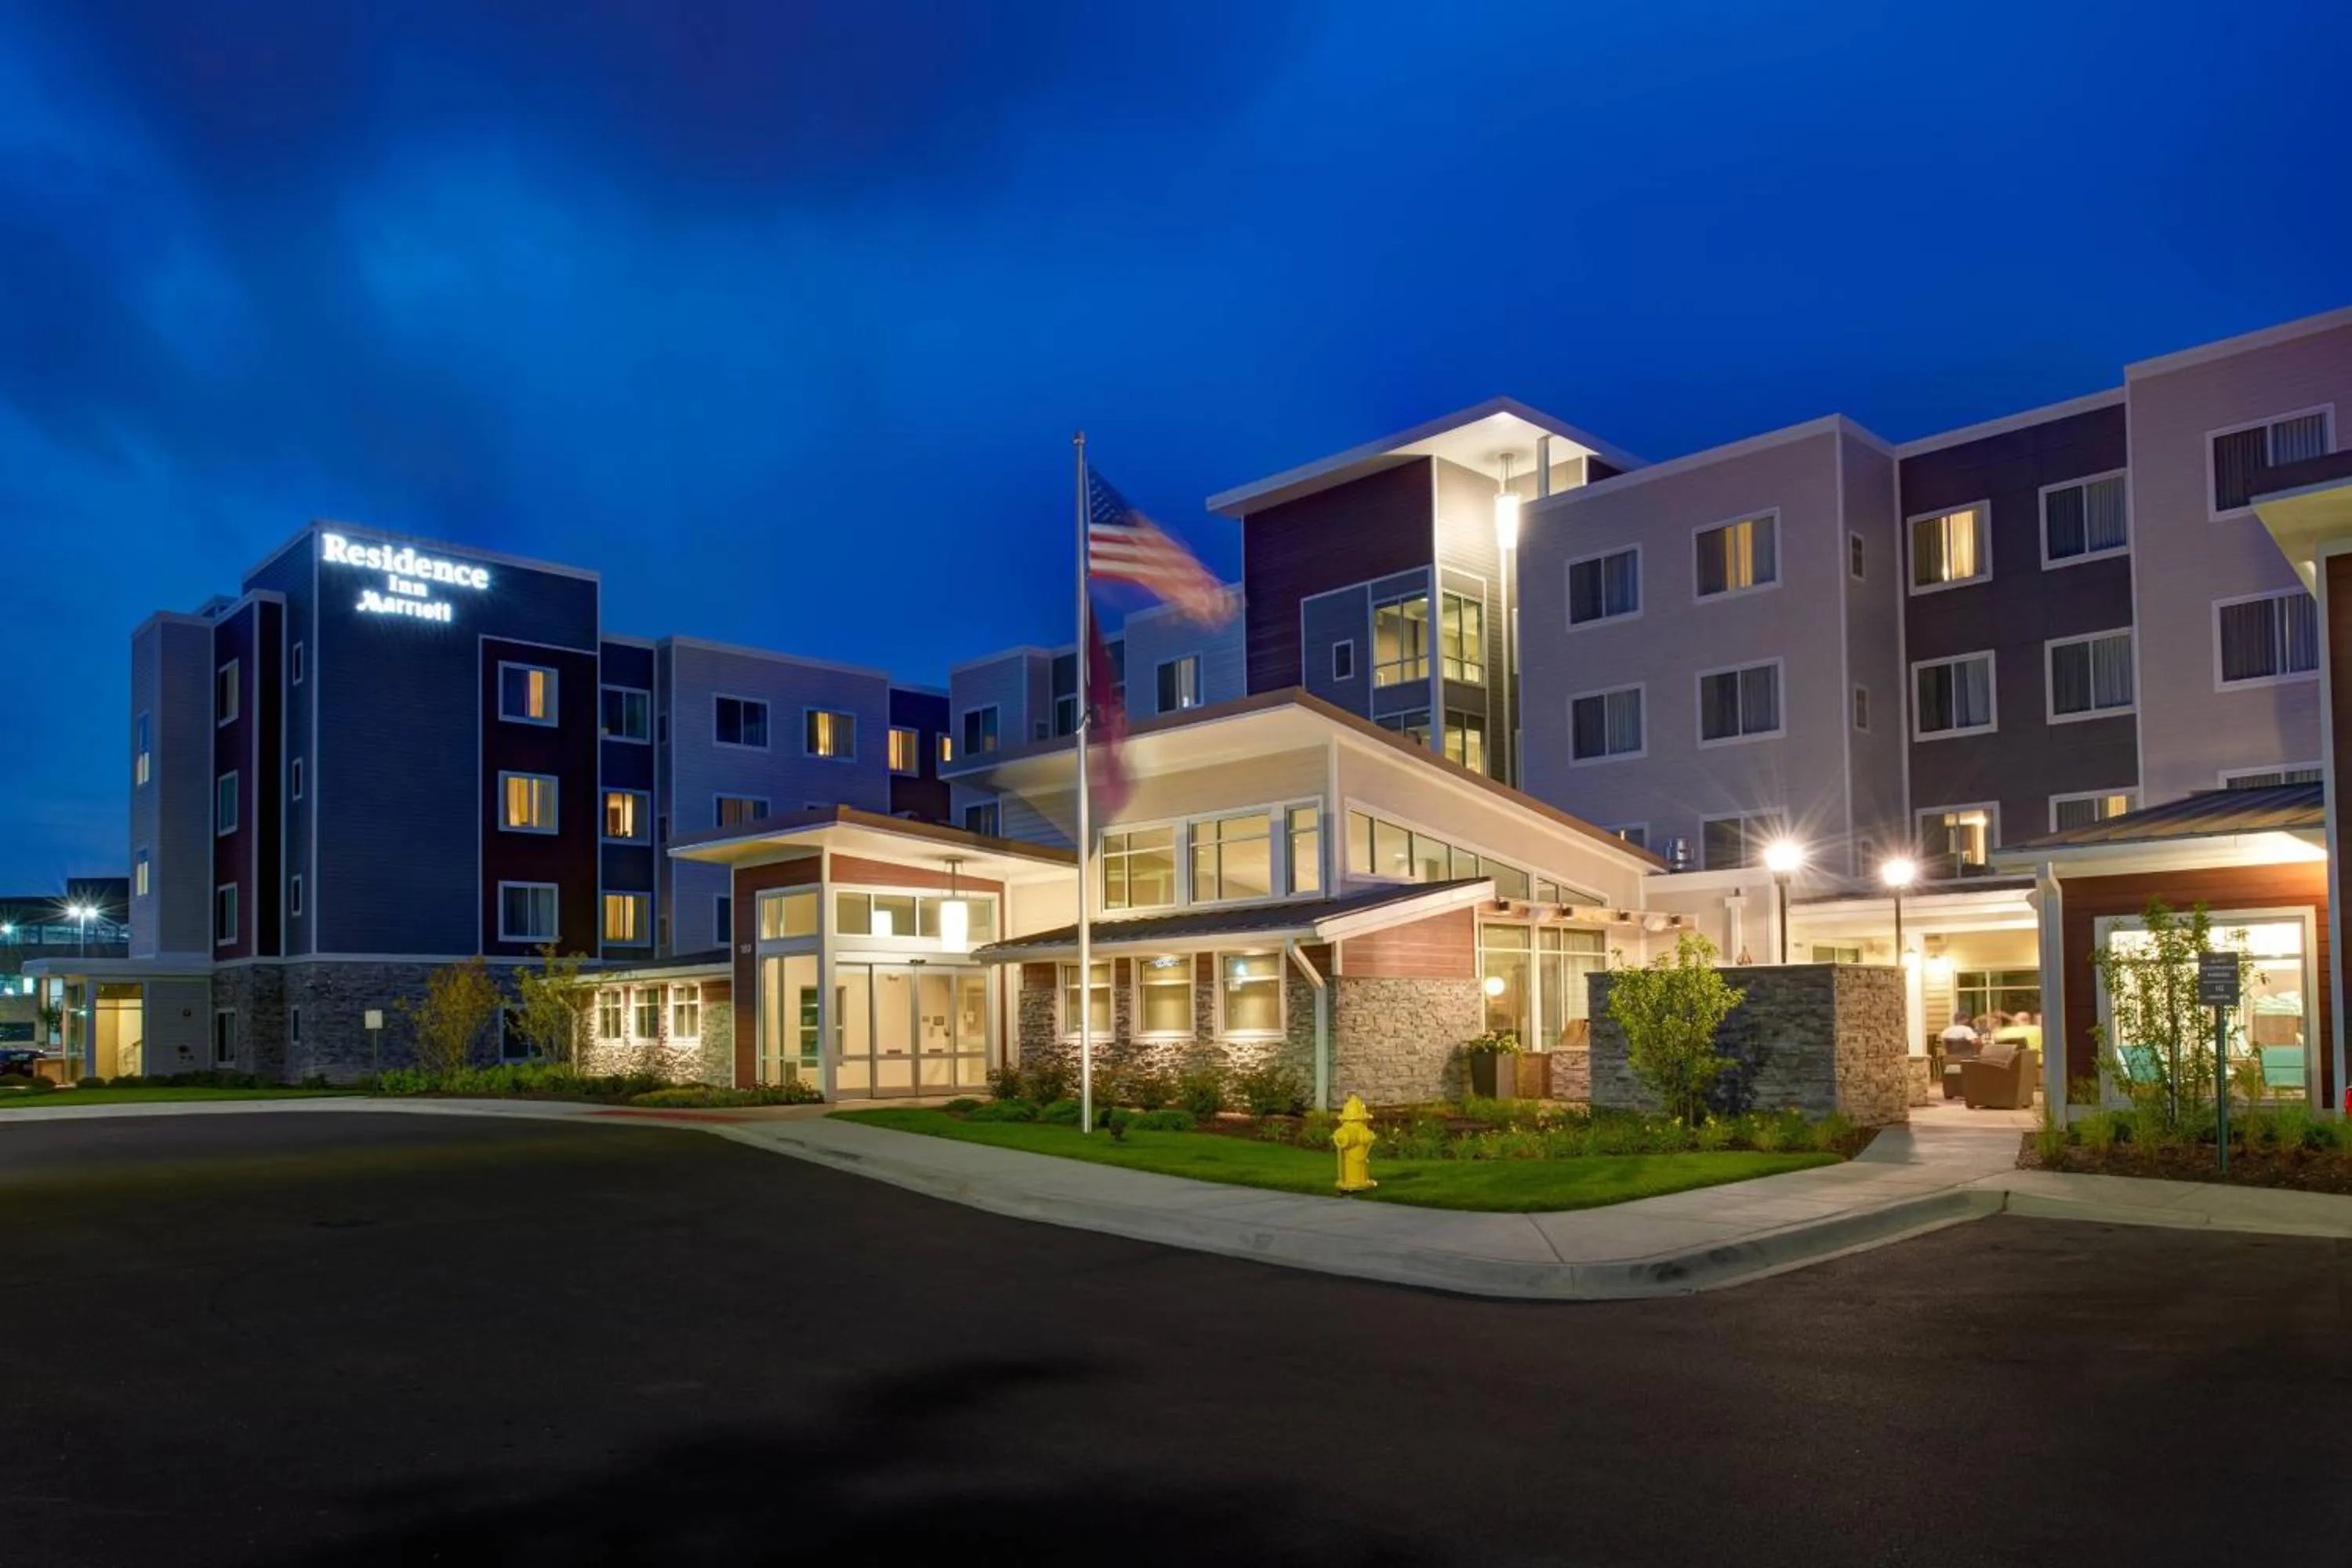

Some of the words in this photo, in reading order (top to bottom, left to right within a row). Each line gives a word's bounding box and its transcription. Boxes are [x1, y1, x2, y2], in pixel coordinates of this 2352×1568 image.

[322, 532, 488, 589] Residence
[388, 574, 428, 597] Inn
[356, 590, 452, 622] Marriott
